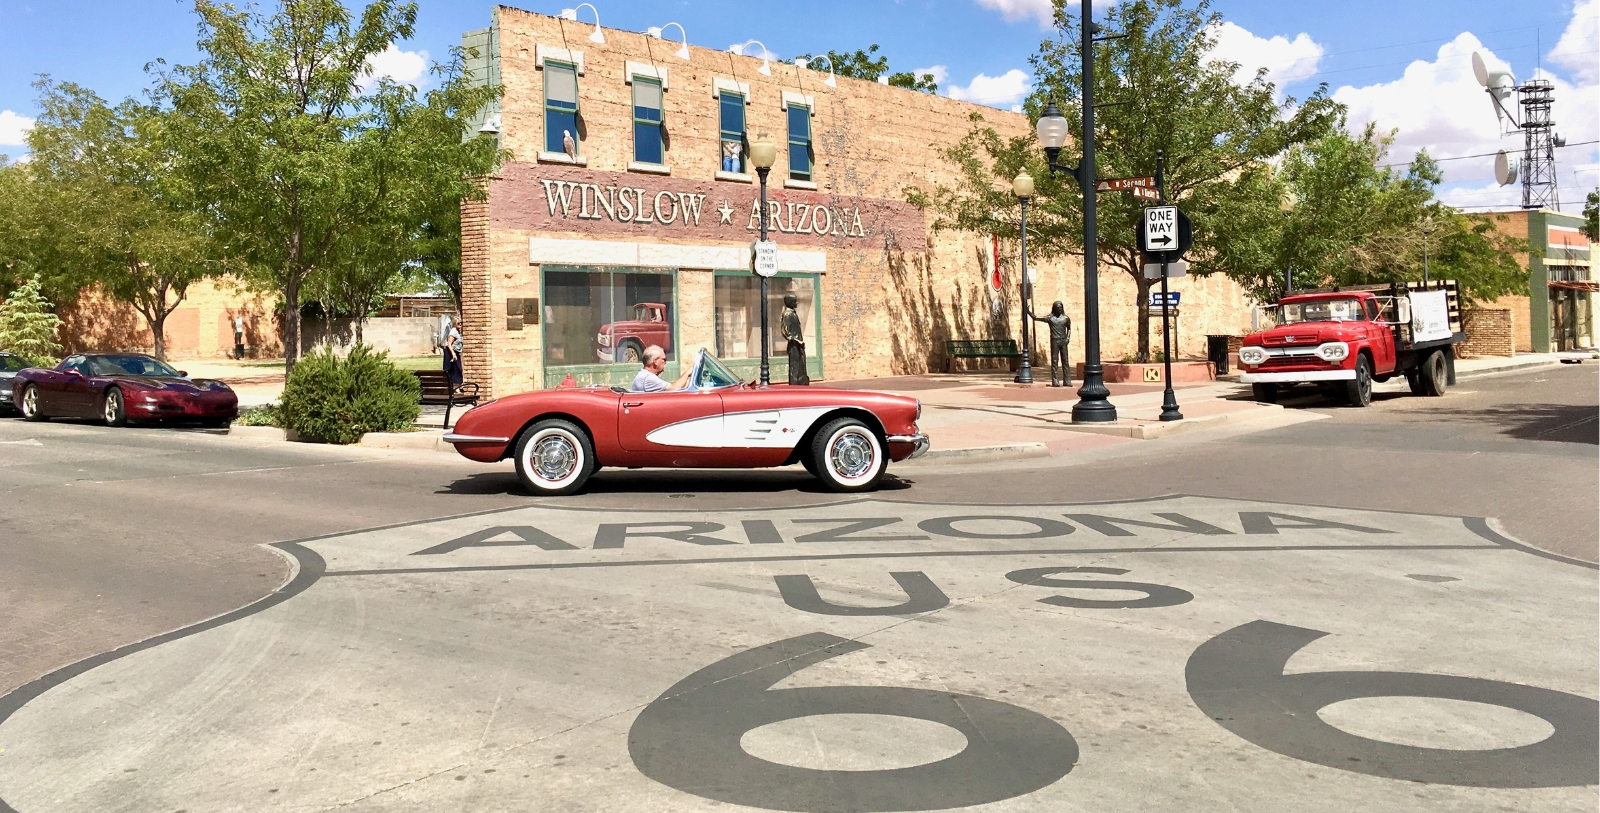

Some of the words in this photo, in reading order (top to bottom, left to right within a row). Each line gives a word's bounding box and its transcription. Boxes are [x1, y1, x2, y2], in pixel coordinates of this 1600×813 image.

[1122, 178, 1146, 188] Second
[540, 179, 707, 227] WINSLOW
[746, 197, 865, 238] ARIZONA
[1150, 210, 1172, 221] ONE
[1149, 222, 1173, 233] WAY
[411, 511, 1402, 555] ARIZONA
[628, 620, 1599, 813] 66
